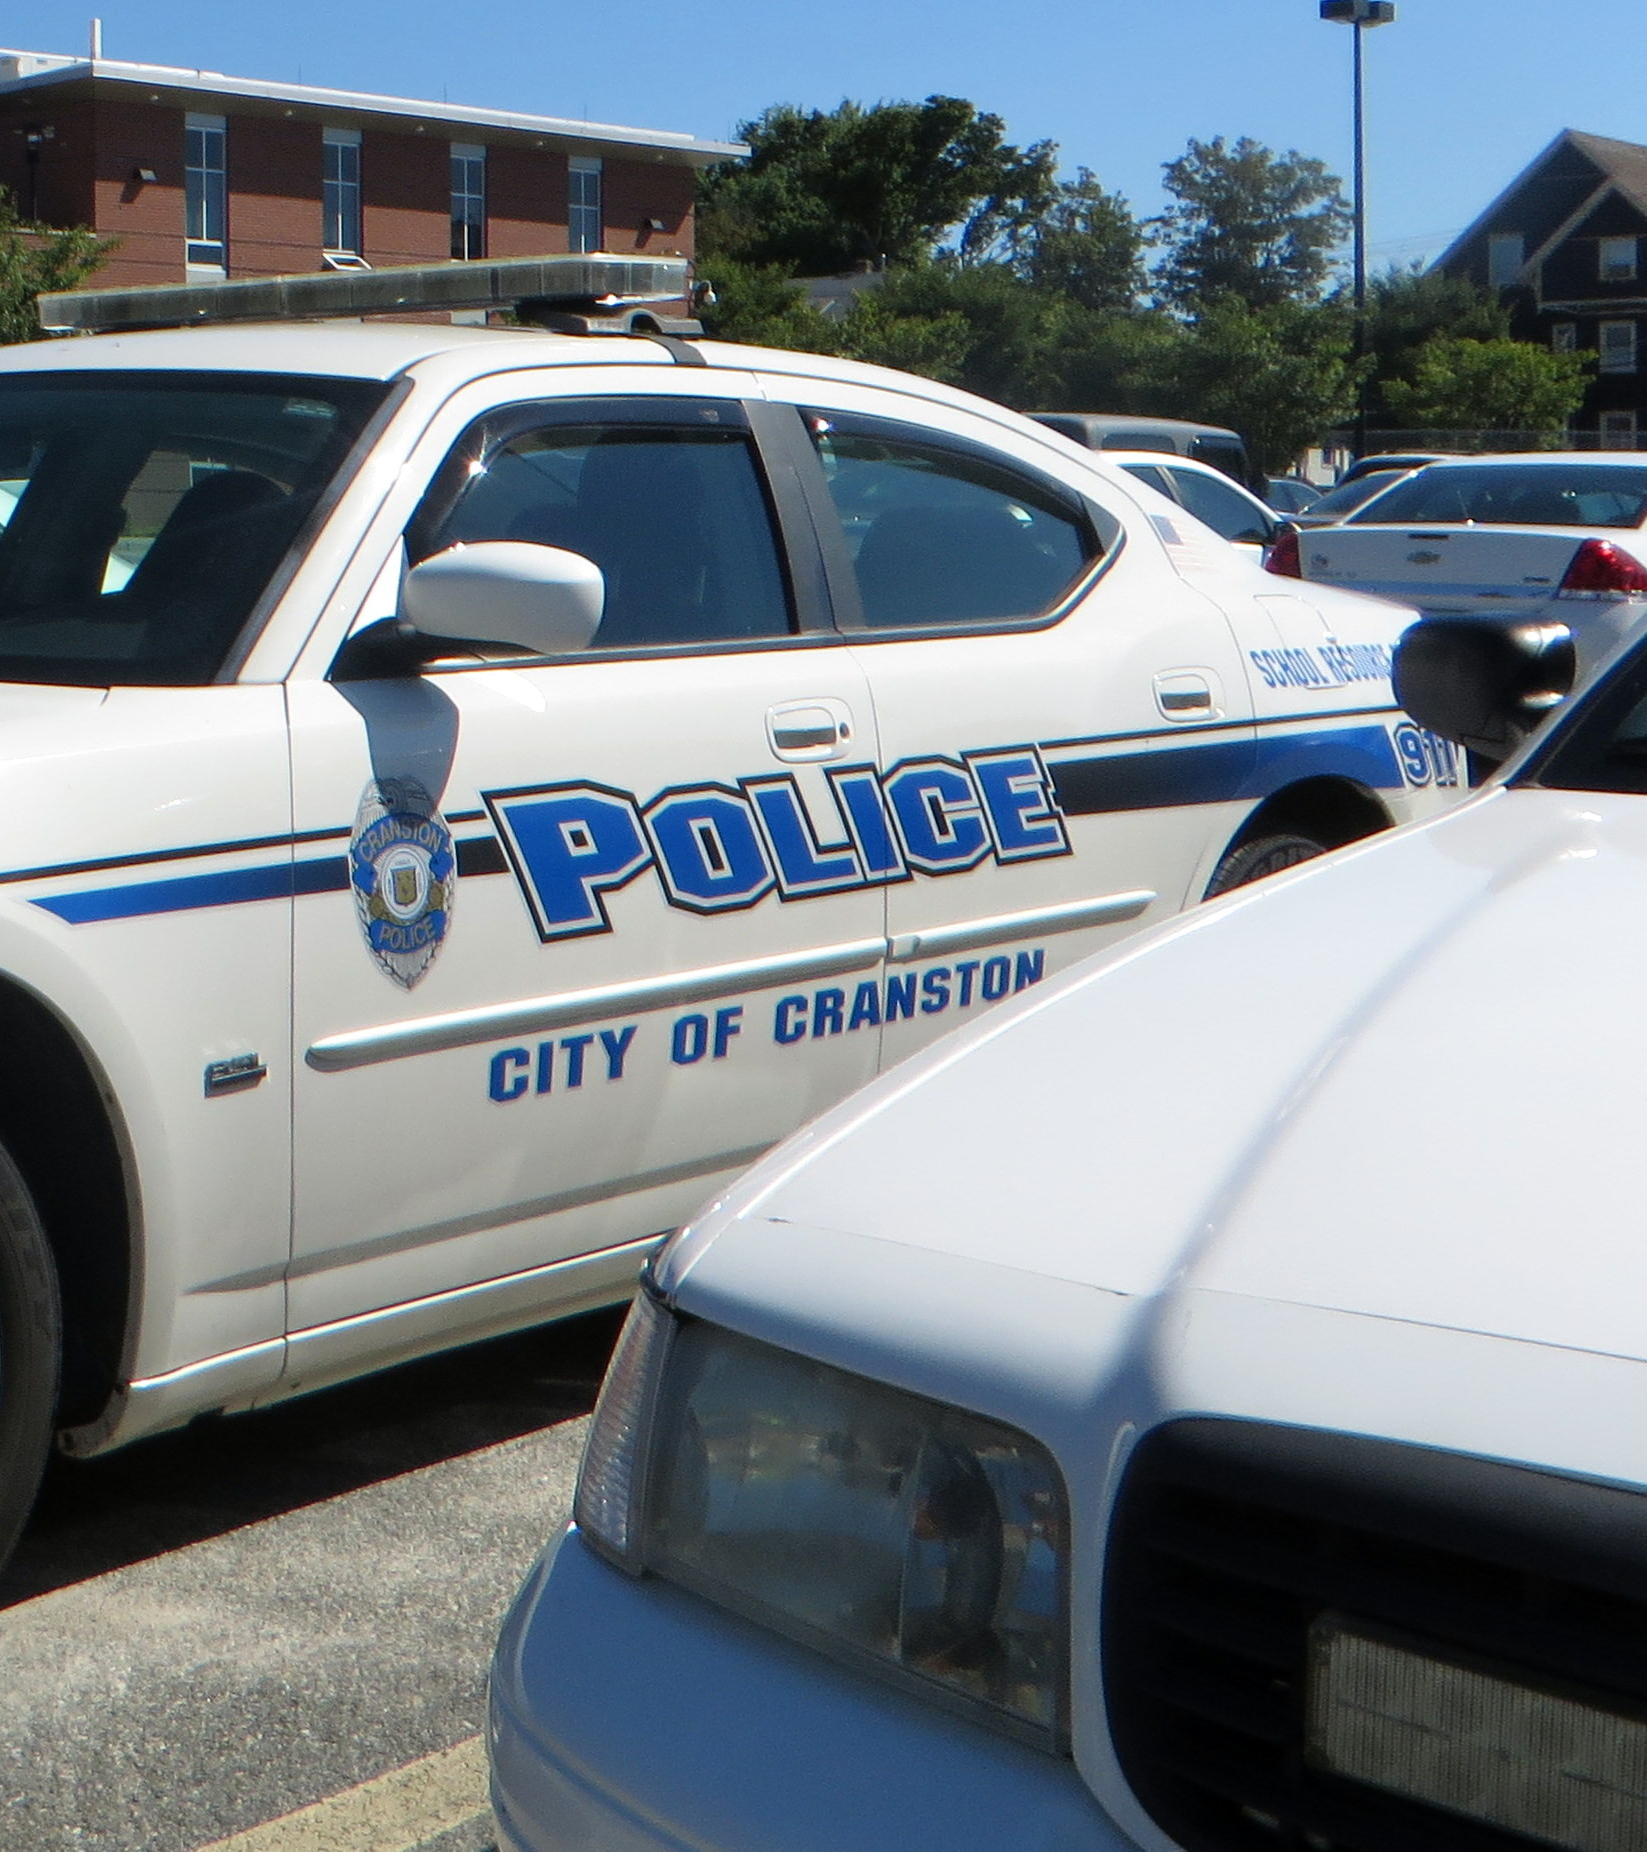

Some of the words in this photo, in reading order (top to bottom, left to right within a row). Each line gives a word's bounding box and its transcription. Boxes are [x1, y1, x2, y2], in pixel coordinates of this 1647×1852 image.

[1250, 648, 1329, 688] SCHOOL
[1394, 721, 1458, 787] 911
[359, 819, 442, 862] CRANSTON
[480, 743, 1073, 943] POLICE
[380, 922, 436, 949] POLICE
[488, 1025, 638, 1104] CITY
[671, 1005, 744, 1066] OF
[773, 948, 1045, 1046] CRANSTON
